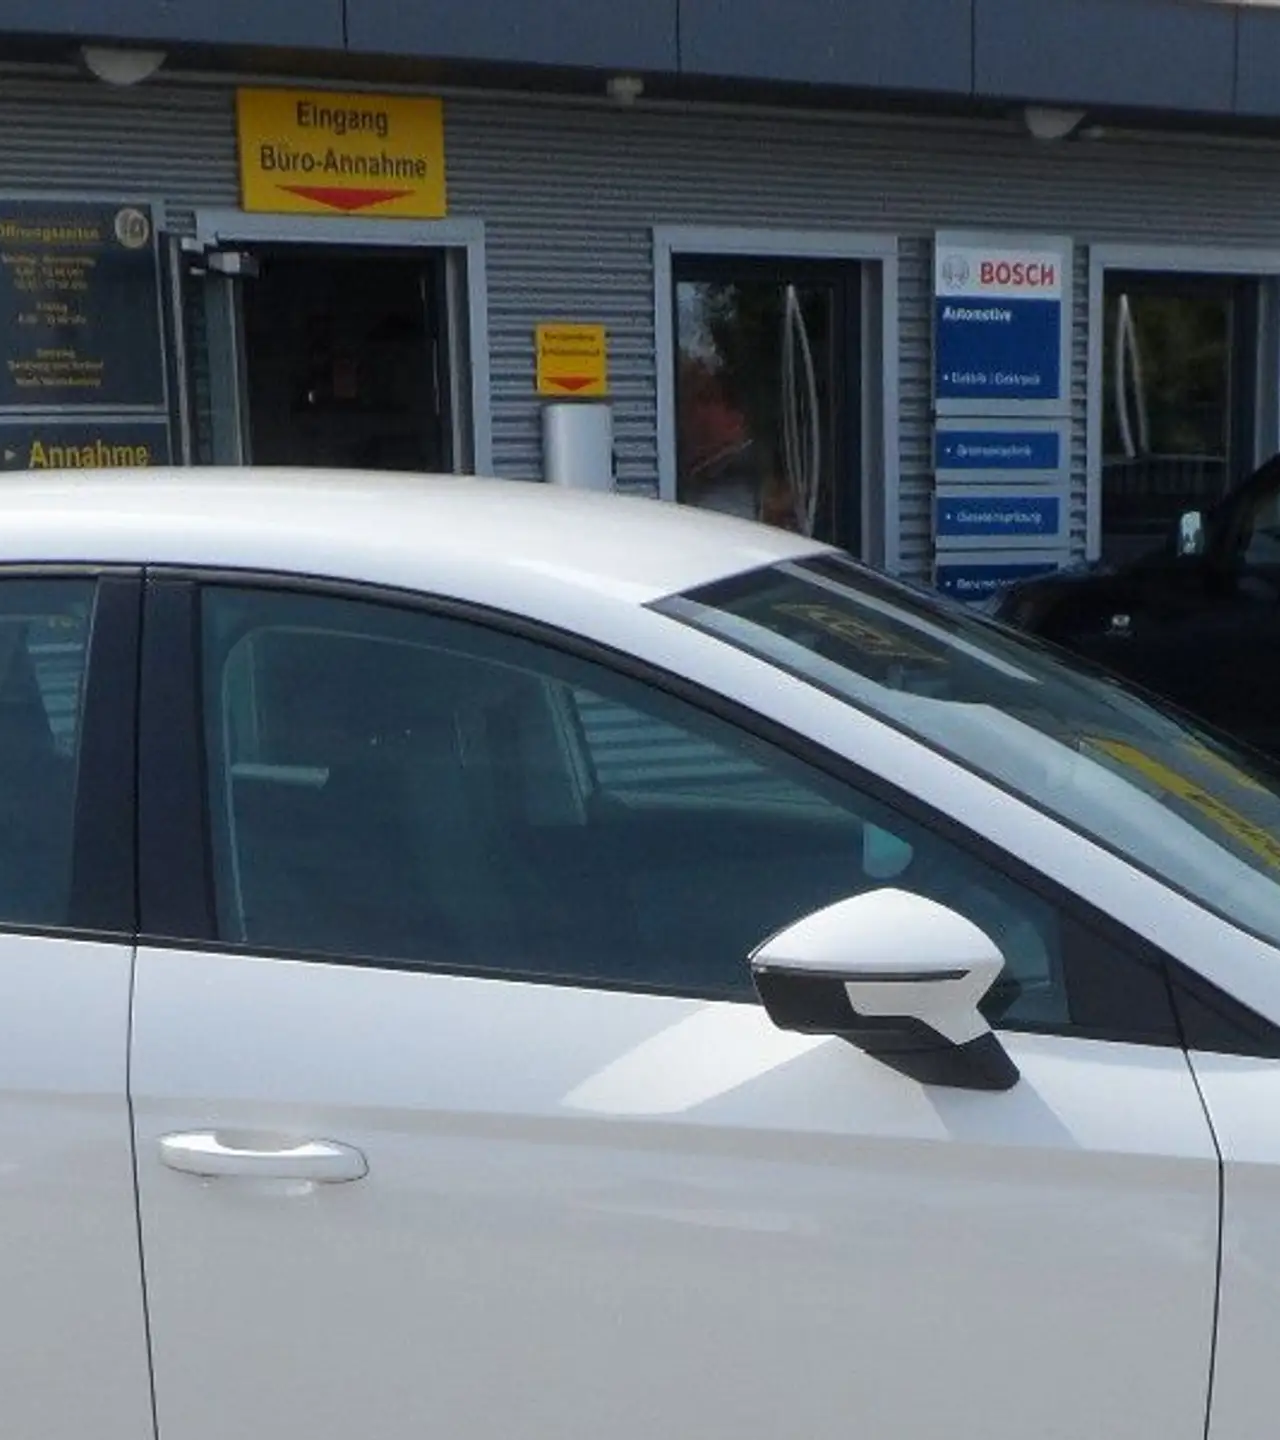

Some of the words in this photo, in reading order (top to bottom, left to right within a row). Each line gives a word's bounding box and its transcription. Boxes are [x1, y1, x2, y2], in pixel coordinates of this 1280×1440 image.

[296, 101, 389, 137] Eingang
[980, 261, 1055, 286] BOSCH
[942, 306, 1012, 323] Automotive
[29, 438, 150, 468] Annahme
